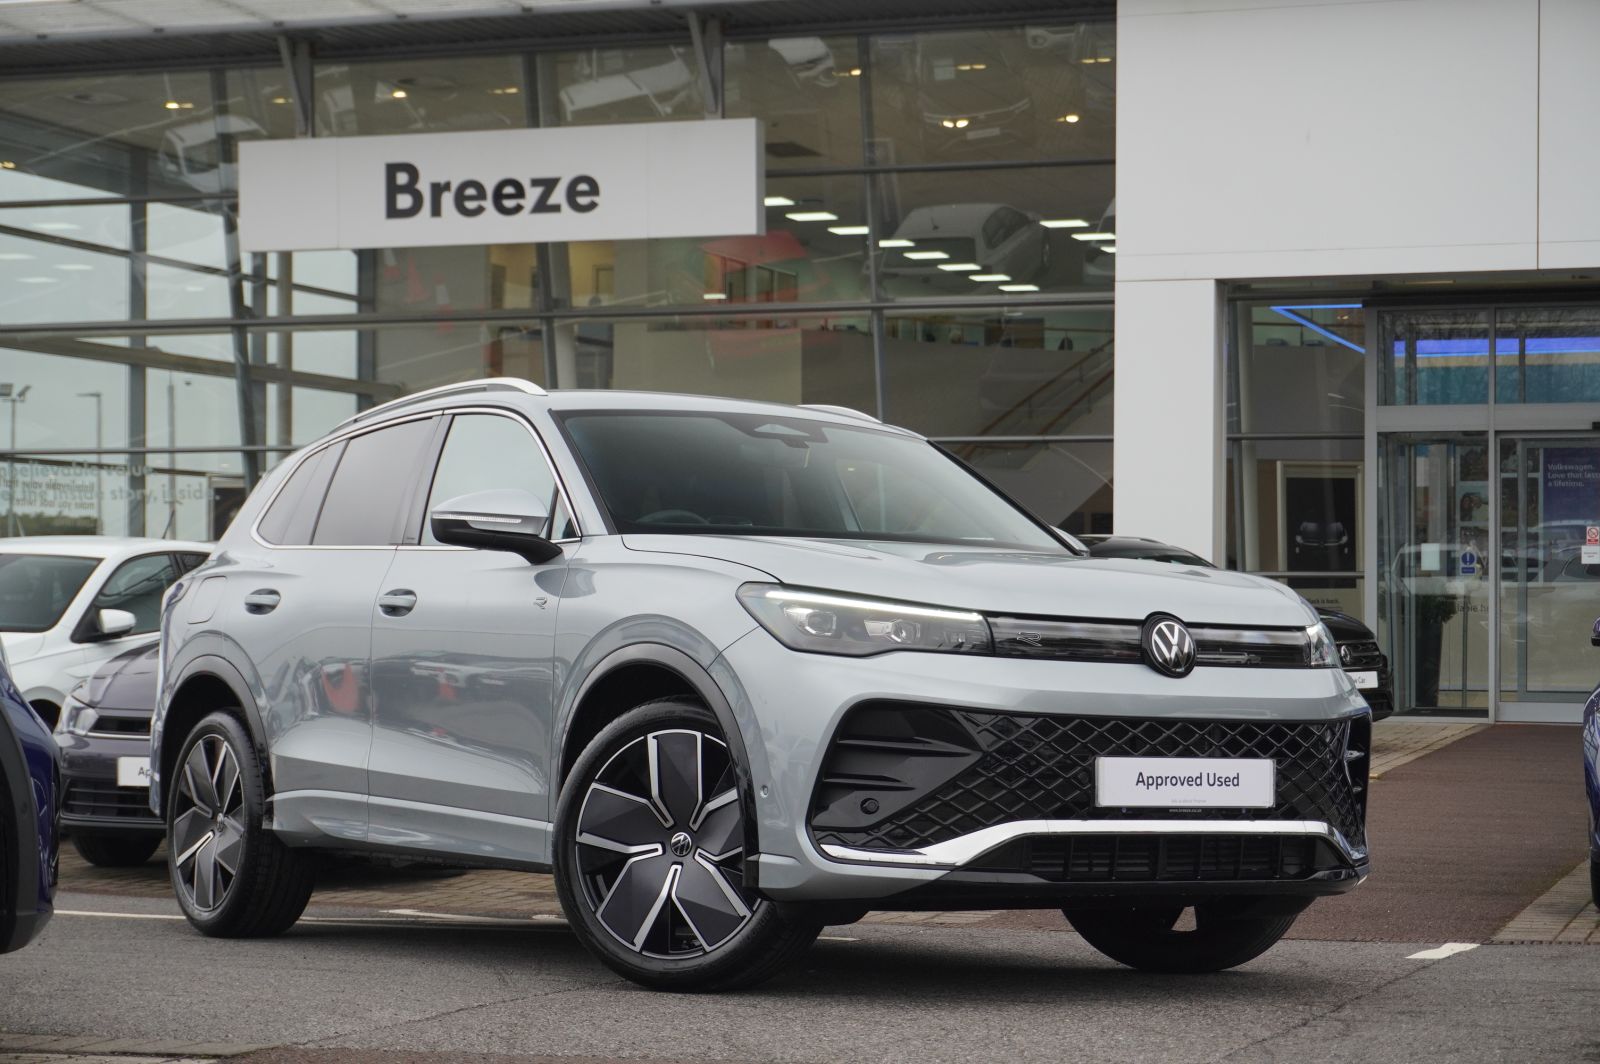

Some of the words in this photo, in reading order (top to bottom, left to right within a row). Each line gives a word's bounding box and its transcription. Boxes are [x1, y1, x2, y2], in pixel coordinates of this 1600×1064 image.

[384, 161, 600, 220] Breeze
[1135, 771, 1203, 790] Approved
[1206, 772, 1240, 787] Used
